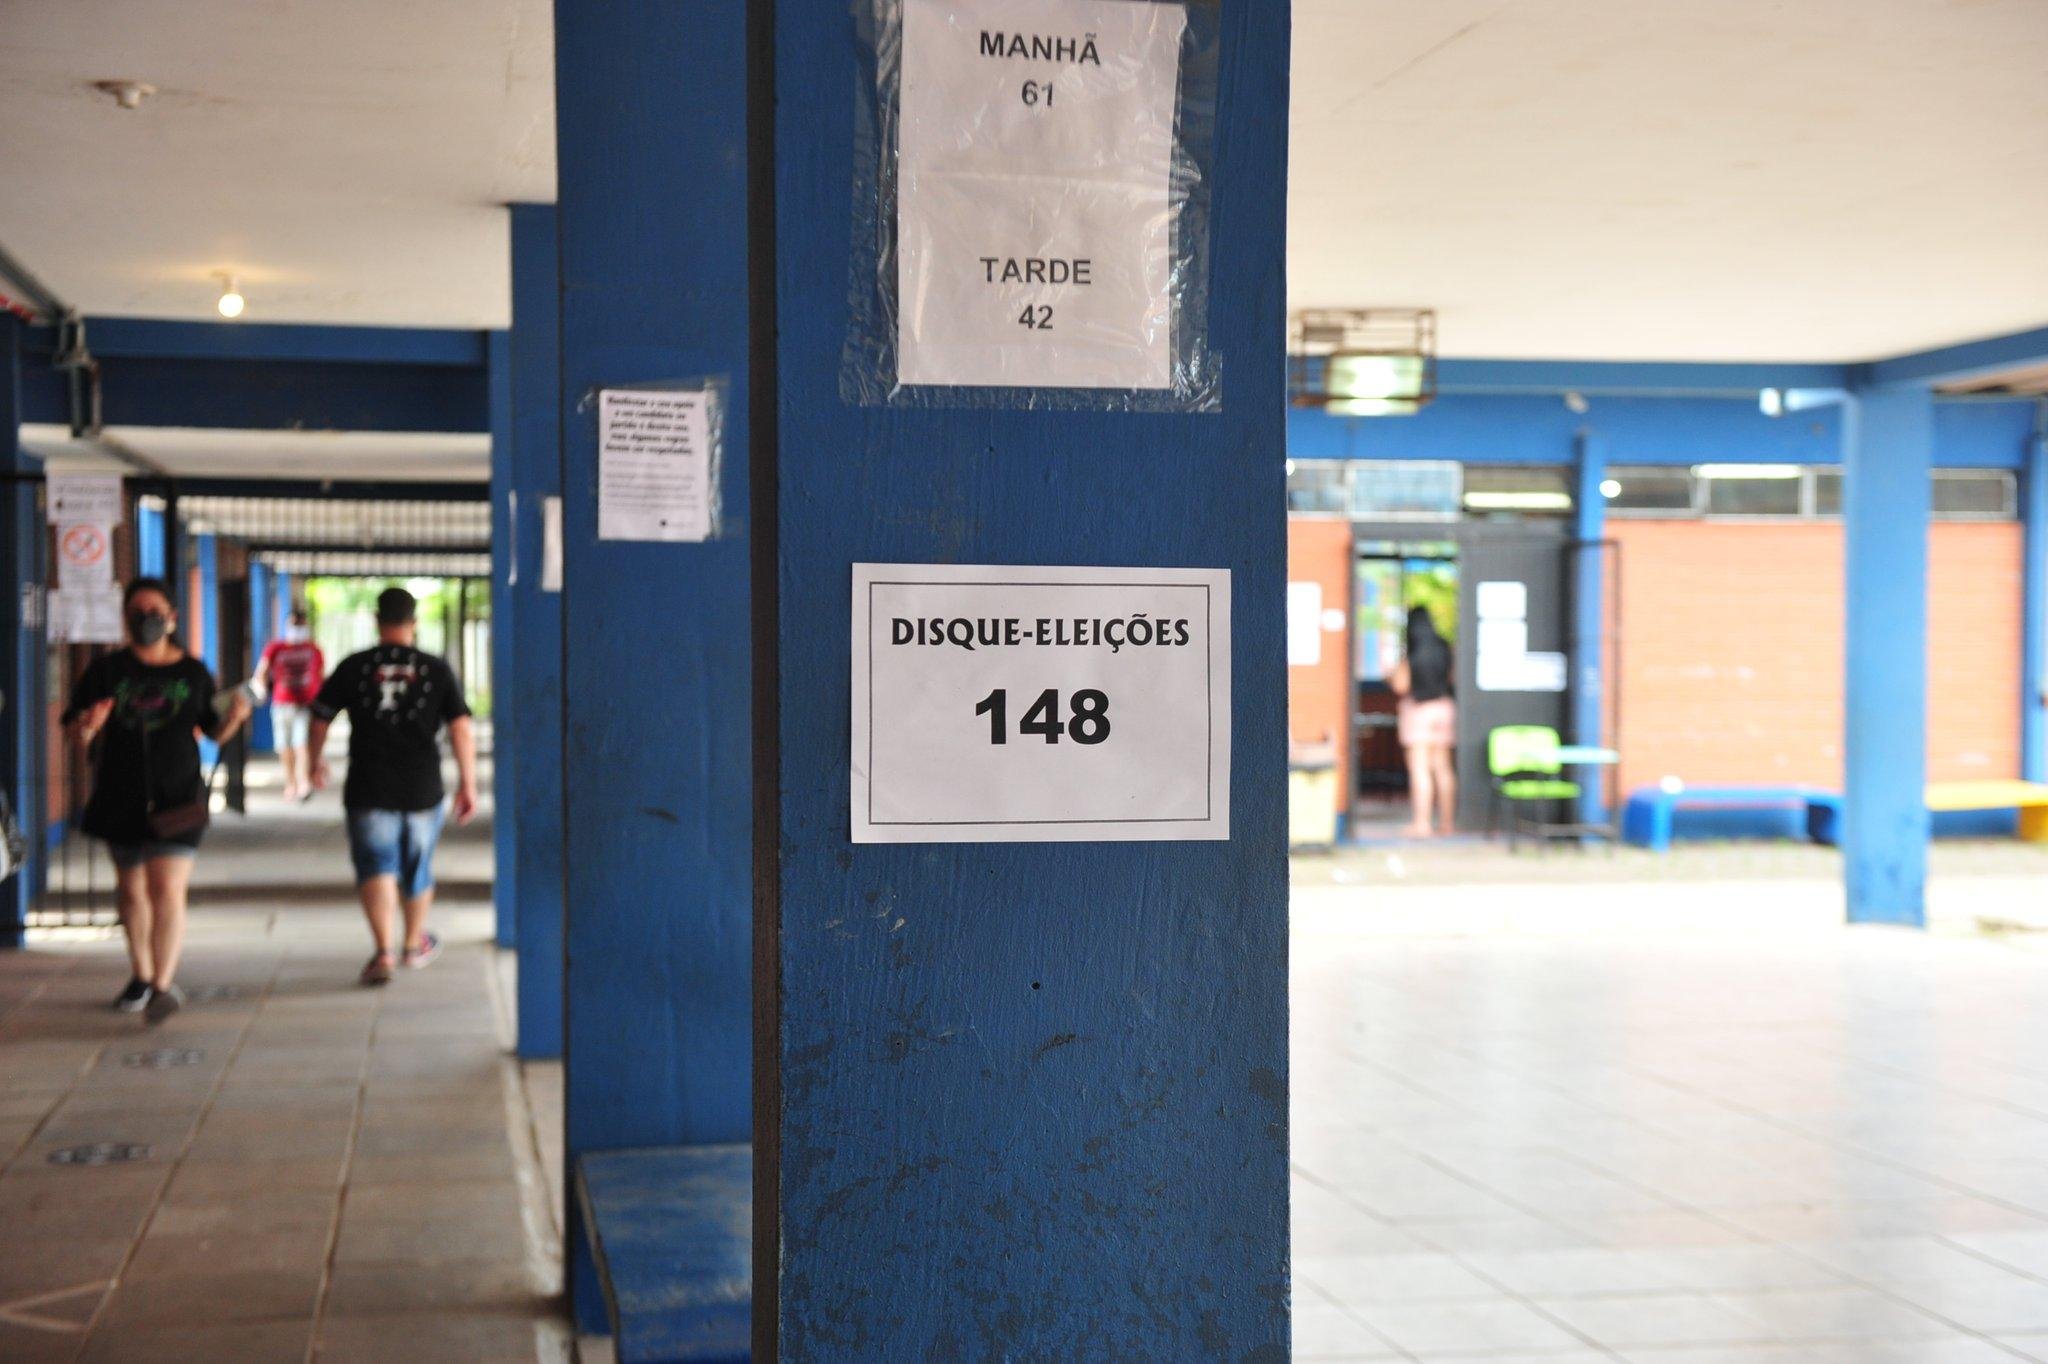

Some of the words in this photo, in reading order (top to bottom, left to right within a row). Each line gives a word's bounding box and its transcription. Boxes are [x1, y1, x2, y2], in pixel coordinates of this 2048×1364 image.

[979, 30, 1101, 66] MANHÃ
[1021, 81, 1053, 107] 61
[980, 257, 1092, 285] TARDE
[1018, 305, 1053, 329] 42
[891, 613, 1190, 653] DISQUE-ELEIÇÕES
[975, 688, 1111, 745] 148
